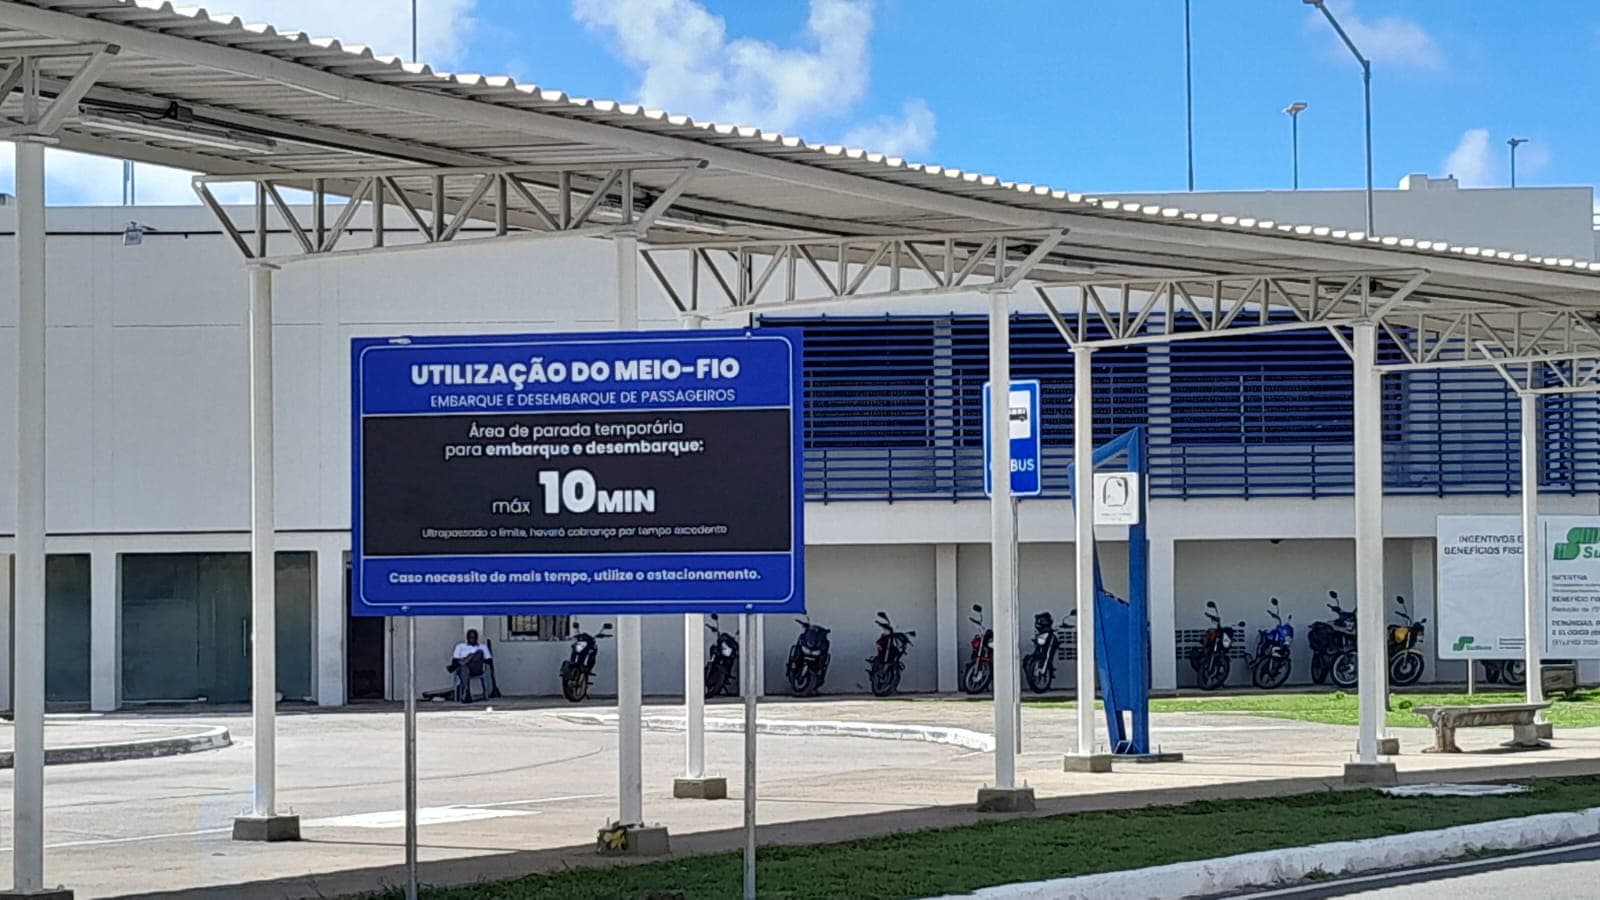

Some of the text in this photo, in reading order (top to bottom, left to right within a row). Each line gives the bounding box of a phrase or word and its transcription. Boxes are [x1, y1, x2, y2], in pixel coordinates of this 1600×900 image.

[411, 357, 740, 391] UTILIZAÇÃO DO MEIO-FIO
[430, 388, 736, 408] EMBARQUE E DESEMBARQUE DE PASSAGEIROS
[468, 419, 684, 441] Área de parada temporária
[445, 440, 704, 460] para embarque e desembarque:
[492, 469, 655, 514] máx 10 MIN
[422, 527, 488, 540] Ultrapassado
[618, 527, 636, 538] por
[638, 525, 672, 537] tempo
[1502, 546, 1524, 555] FISC
[389, 568, 761, 585] Caso necessite de mais tempo, utilize o estacionamento.
